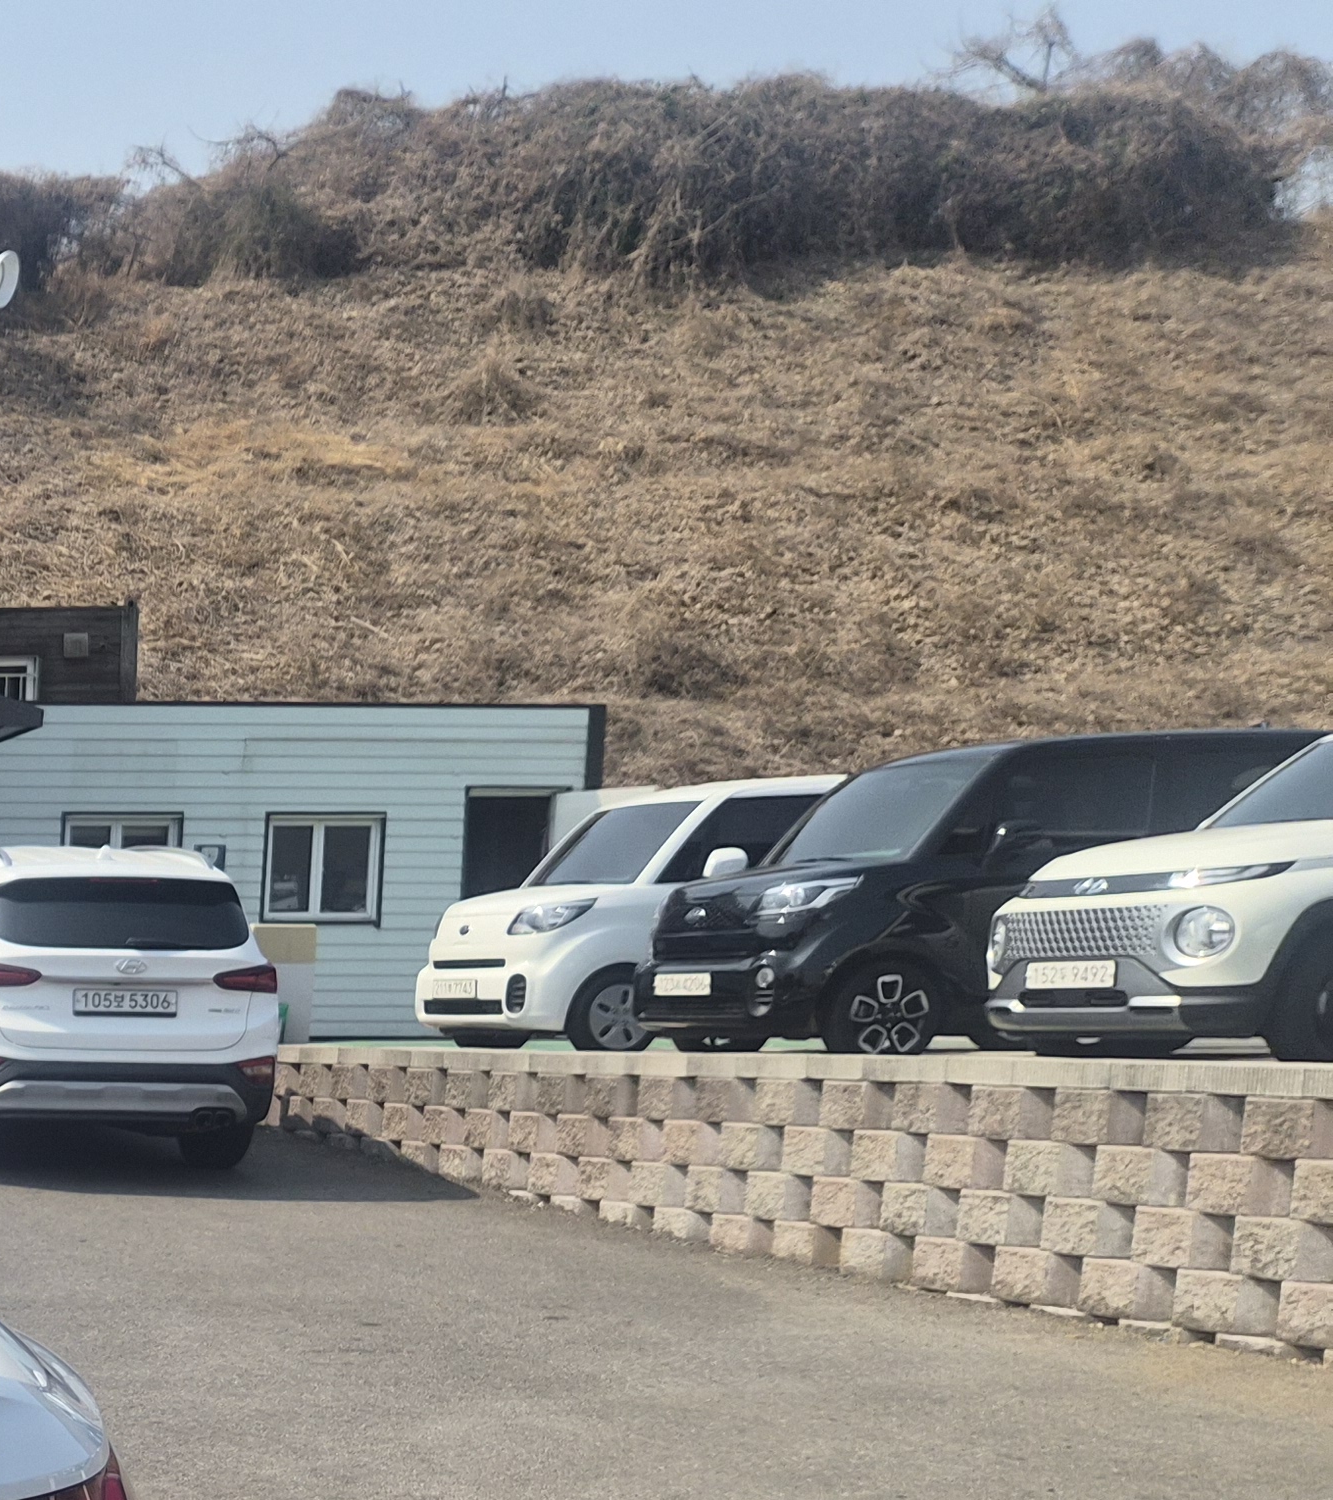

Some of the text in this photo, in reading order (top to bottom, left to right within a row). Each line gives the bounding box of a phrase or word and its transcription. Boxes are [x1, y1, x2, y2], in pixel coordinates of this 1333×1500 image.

[1073, 966, 1109, 983] 9492
[81, 992, 171, 1010] 105보 5306
